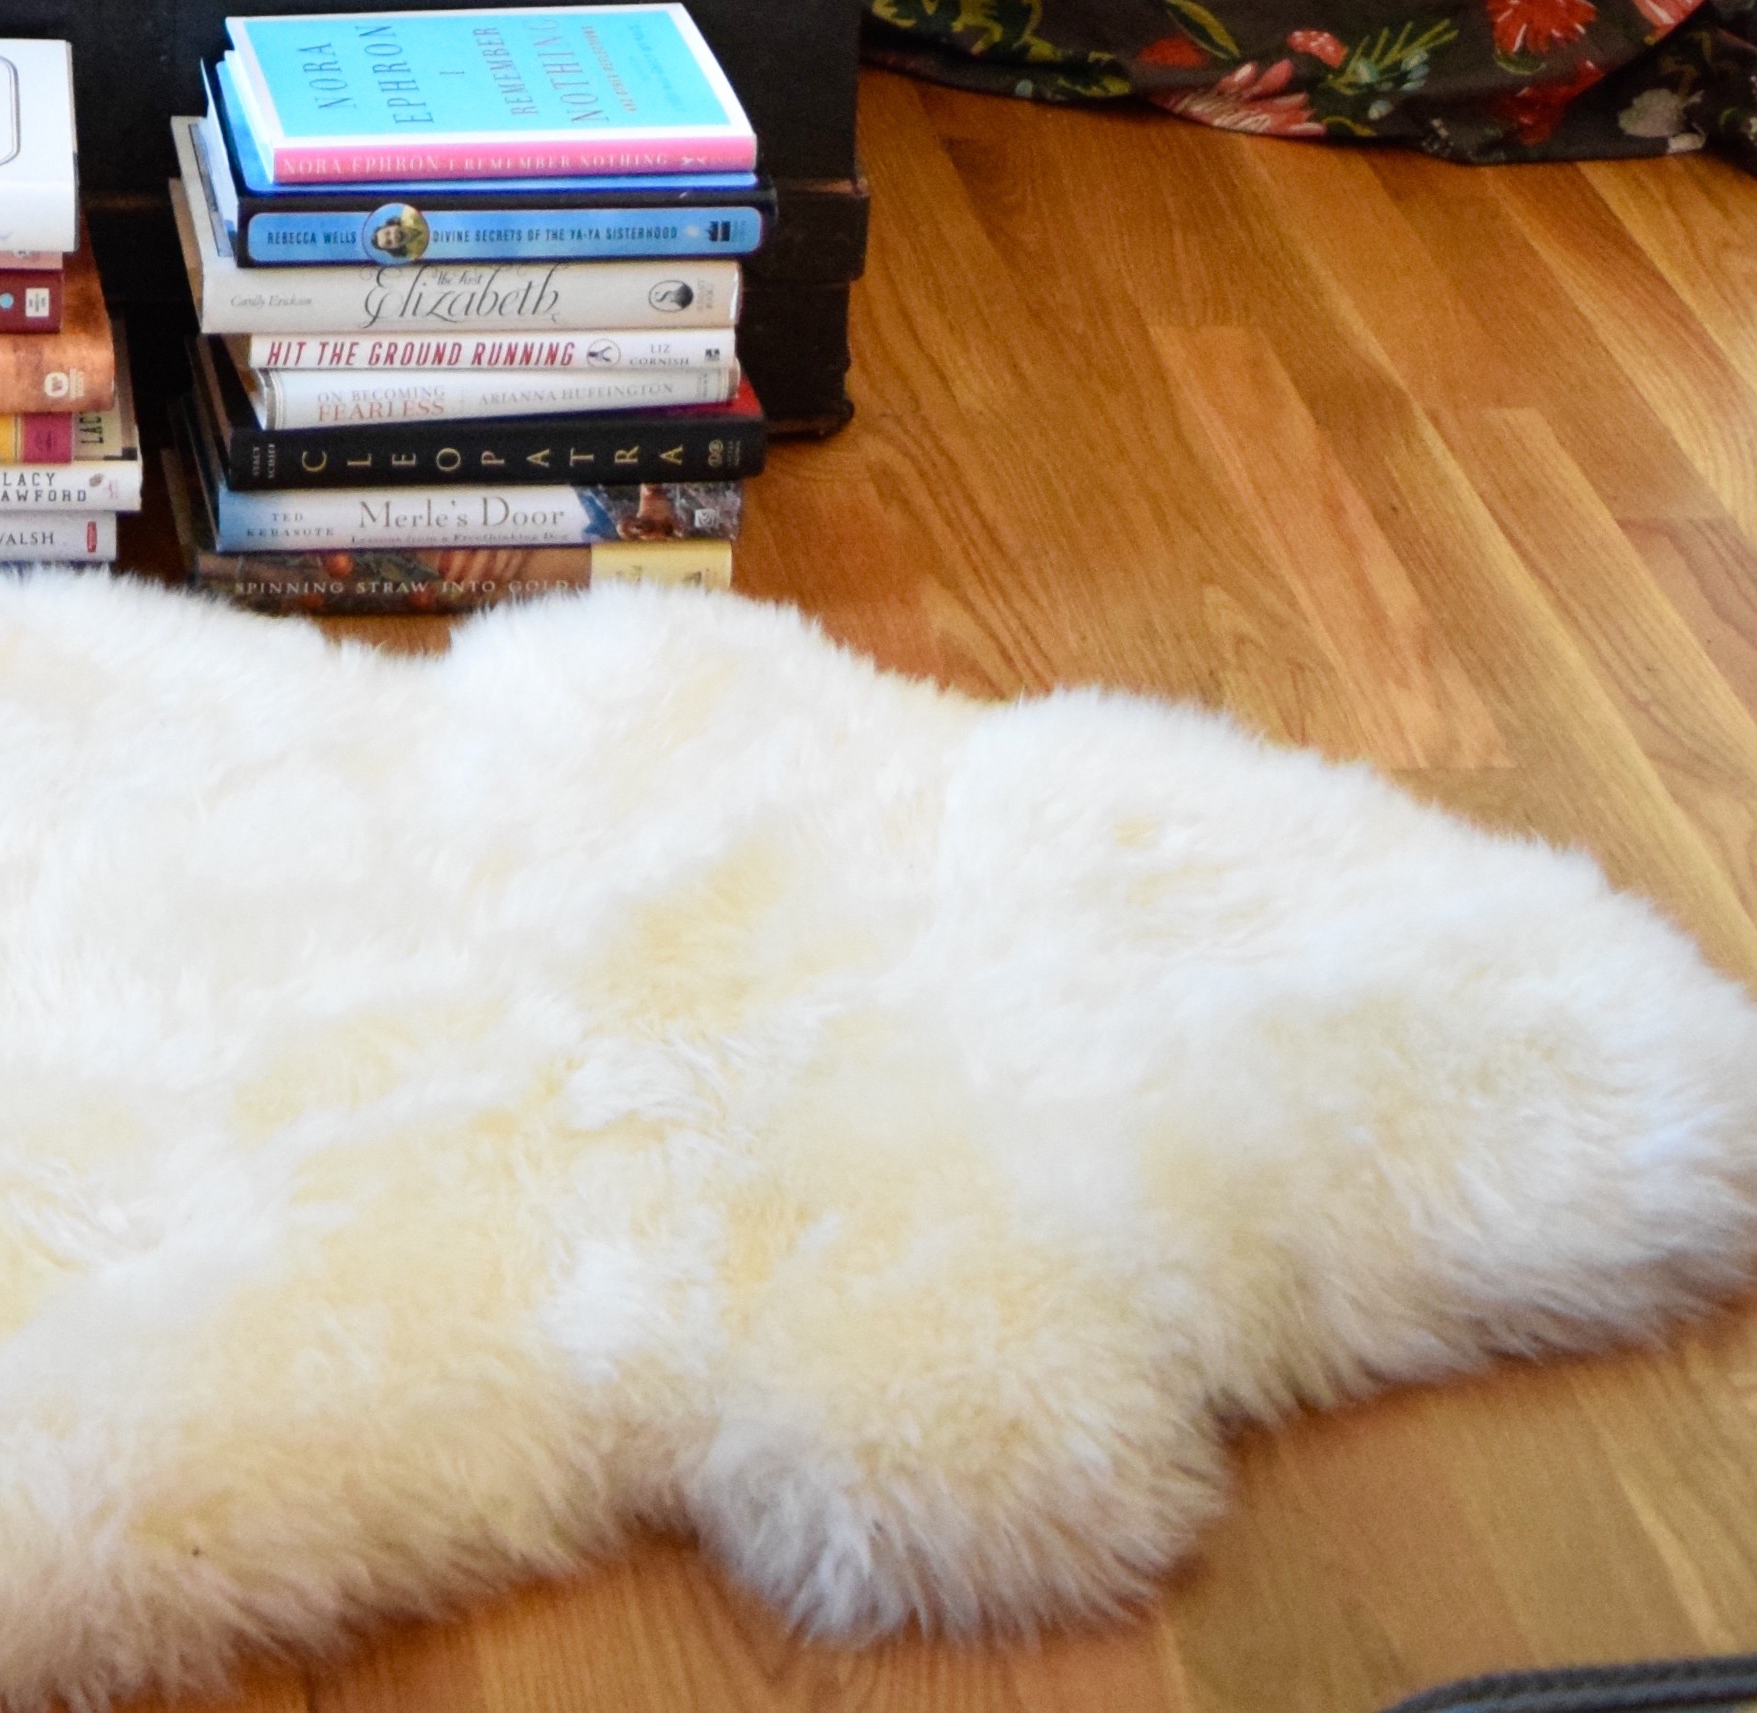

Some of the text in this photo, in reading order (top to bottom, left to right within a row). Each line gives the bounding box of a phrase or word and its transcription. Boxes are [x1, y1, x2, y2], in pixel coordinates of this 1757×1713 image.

[297, 42, 357, 109] NORA
[355, 25, 434, 124] EPHRON
[472, 27, 539, 116] REMEMBER
[523, 18, 610, 123] NOTHING
[284, 158, 341, 174] NORA
[351, 155, 440, 173] EPHRON
[464, 156, 571, 170] REMEMBER
[580, 154, 668, 166] NOTHING
[267, 231, 357, 244] REBECCA WELLS
[433, 226, 678, 243] DIVINE SECRETS OF THE YA-YA SISTERHOOD
[360, 263, 560, 329] Elizabeth
[266, 341, 576, 366] HIT THE GROUND RUNNING
[649, 344, 672, 354] LIZ
[629, 357, 690, 365] CORNISH
[317, 386, 446, 403] ON BECOMING
[478, 390, 557, 406] ARIANNA
[318, 400, 446, 422] FEARLESS
[301, 443, 684, 473] CLEOPATRA
[2, 472, 56, 486] LACY
[271, 513, 304, 522] TED
[358, 496, 566, 529] Merle's Door
[234, 581, 343, 595] SPINNING
[356, 581, 429, 594] STRAW
[442, 580, 496, 593] INTO
